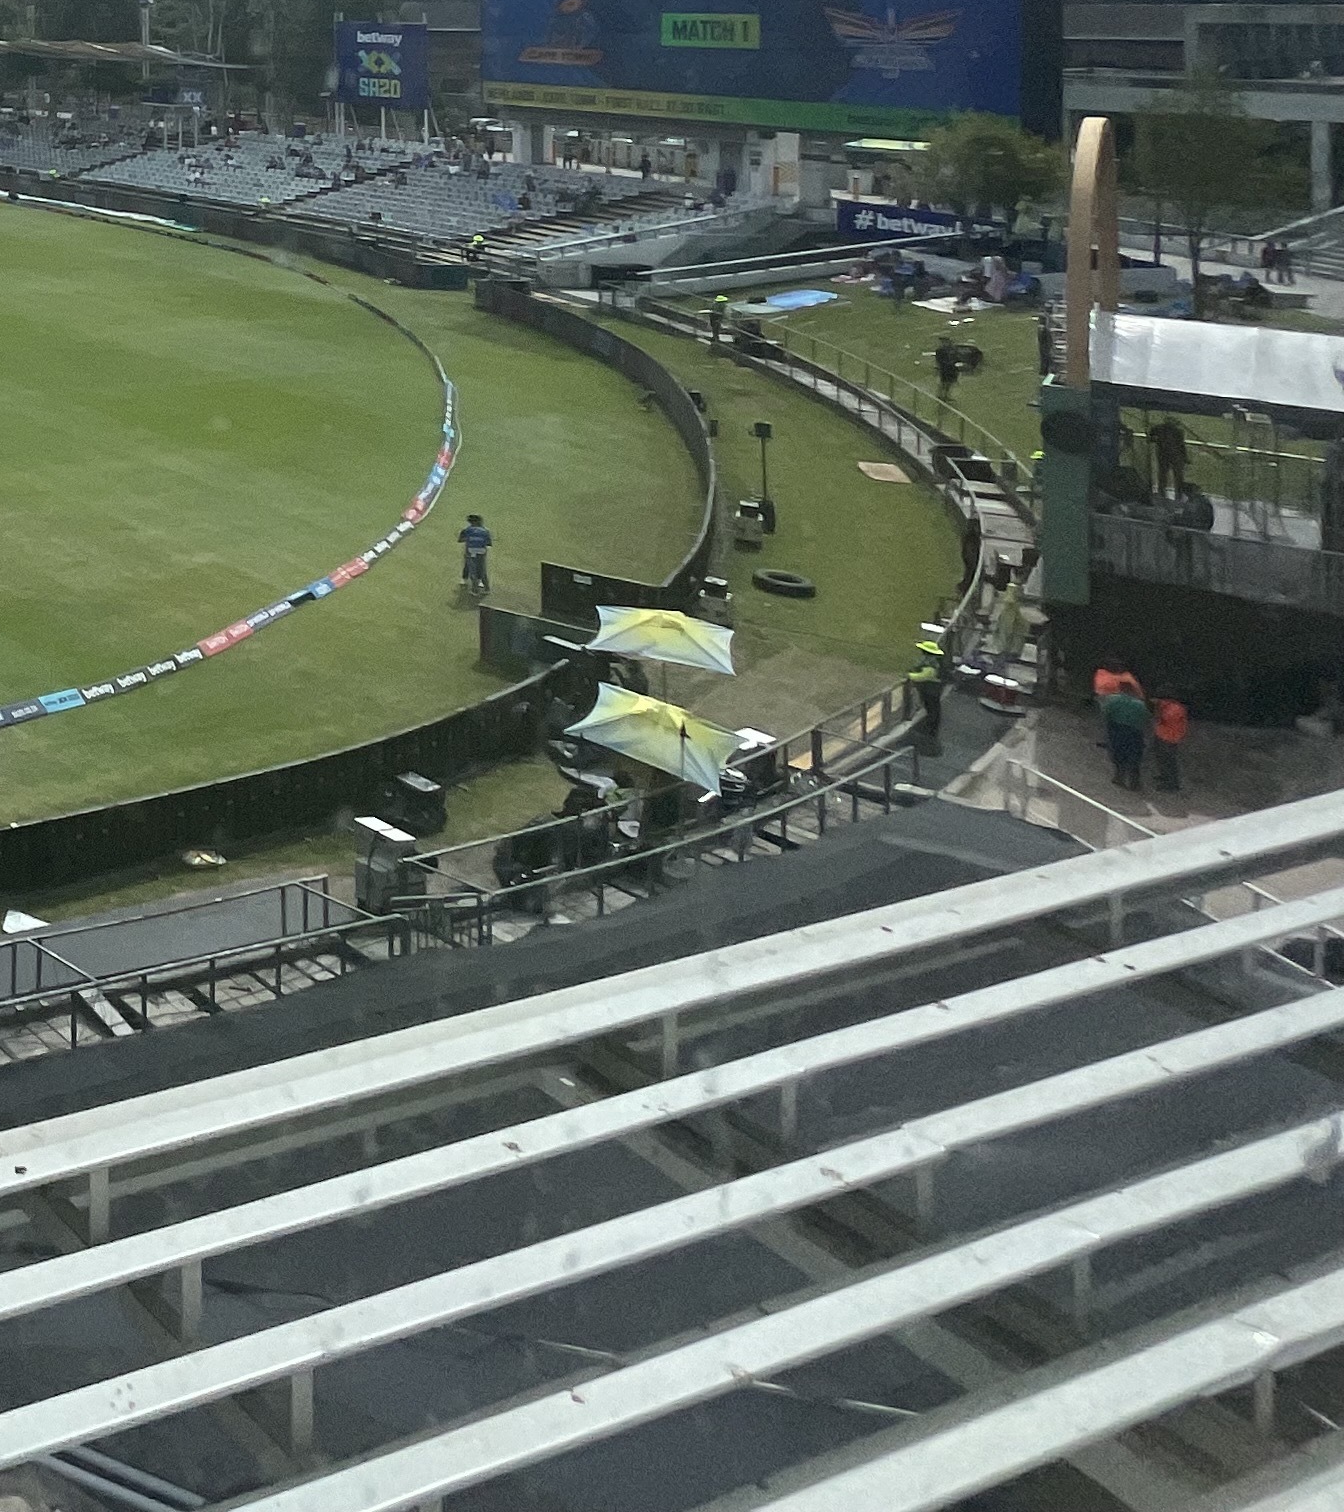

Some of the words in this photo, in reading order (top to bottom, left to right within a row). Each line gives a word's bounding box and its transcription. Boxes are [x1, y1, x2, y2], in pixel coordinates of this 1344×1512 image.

[356, 31, 402, 46] betway
[672, 20, 734, 42] MATCH
[742, 20, 749, 42] 1
[359, 78, 401, 98] SA20
[82, 682, 114, 700] betway
[116, 670, 147, 688] betway
[148, 659, 177, 677] betway
